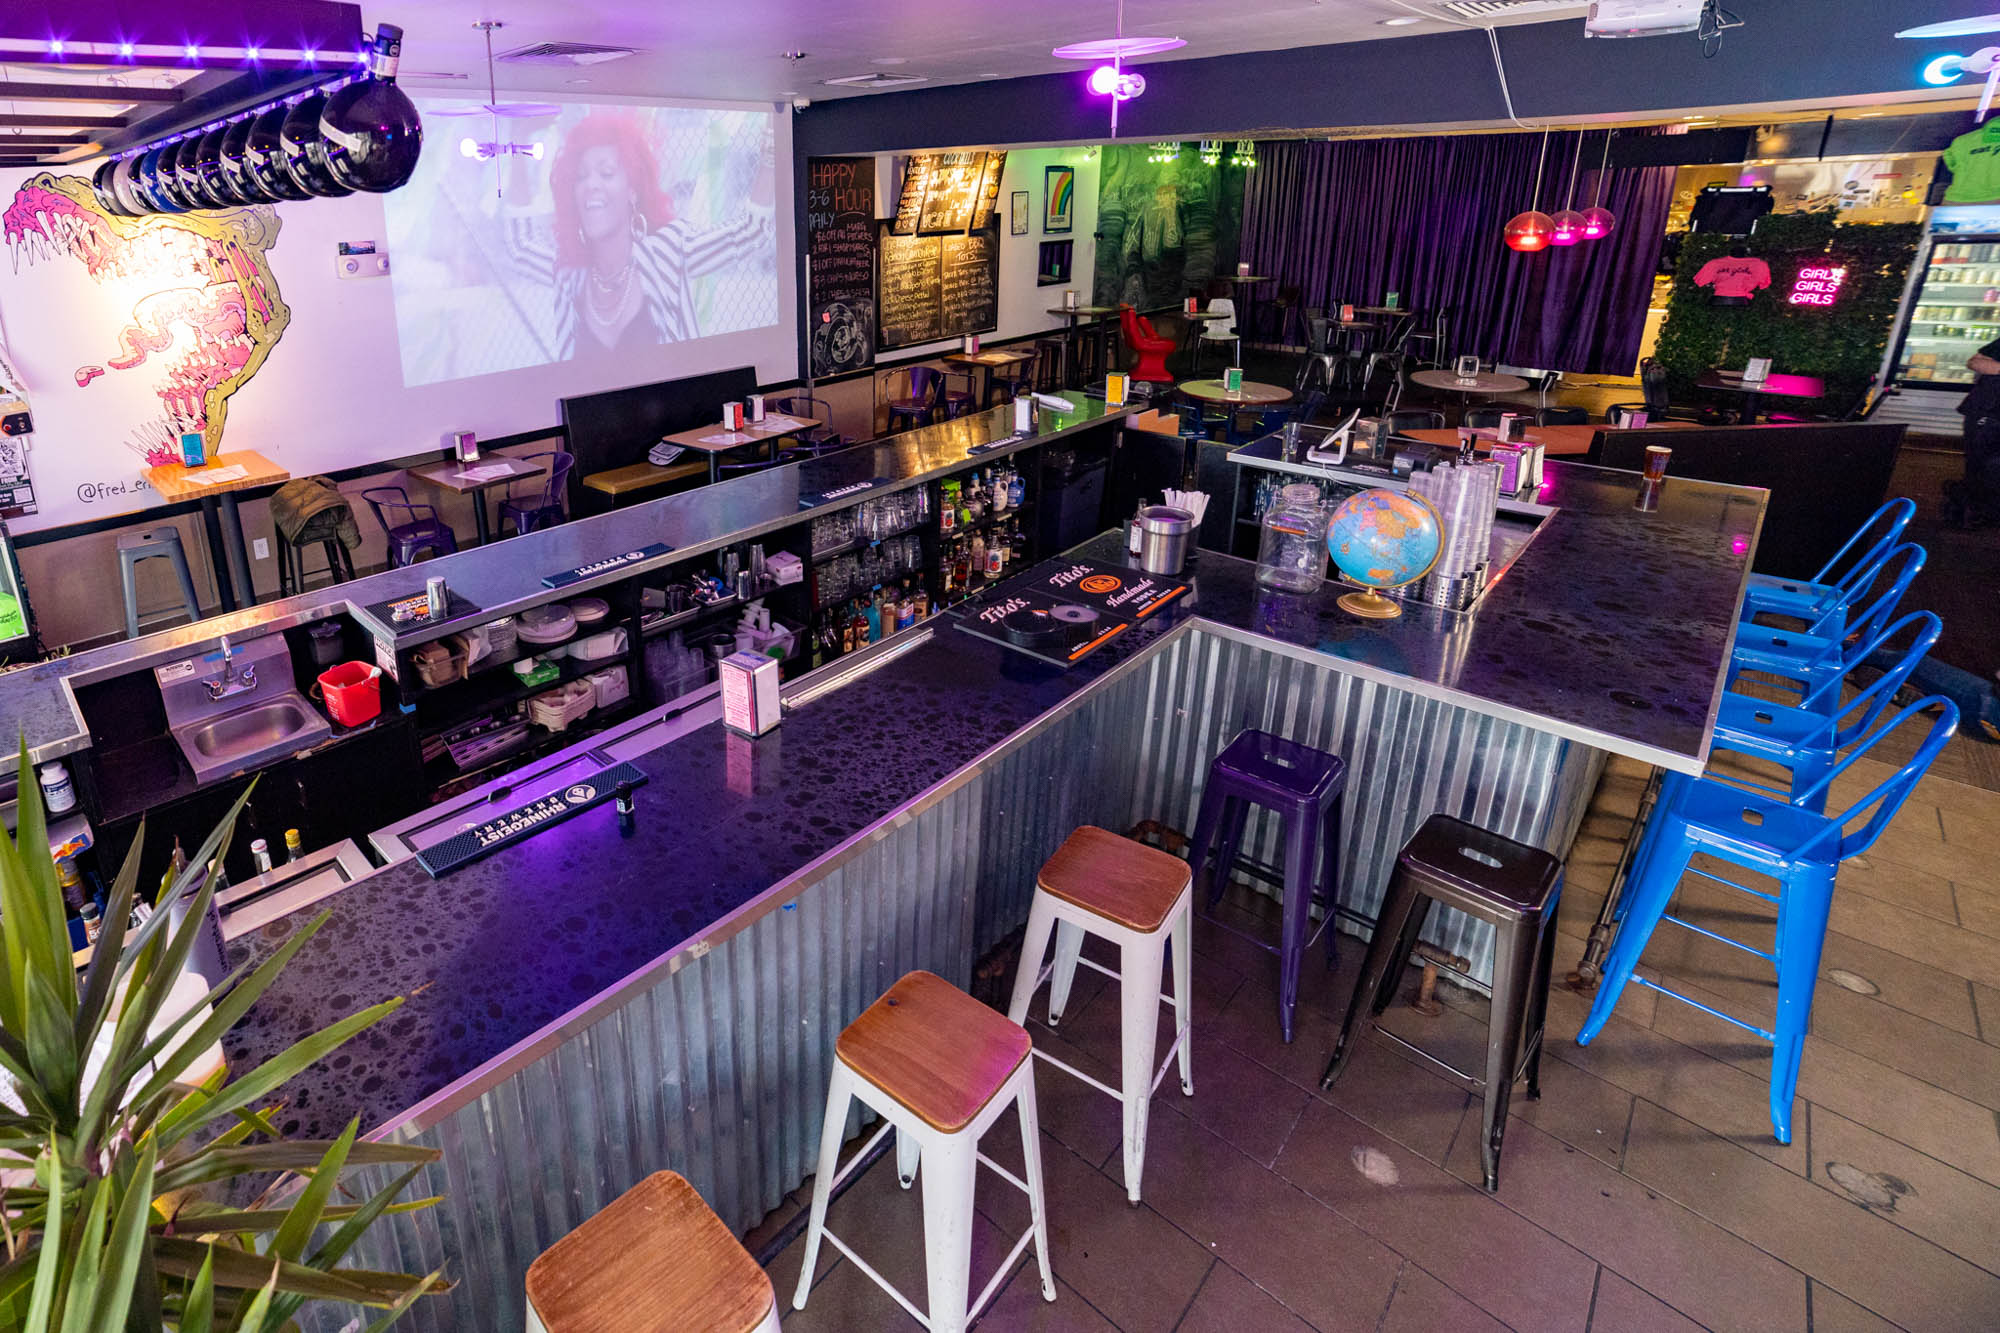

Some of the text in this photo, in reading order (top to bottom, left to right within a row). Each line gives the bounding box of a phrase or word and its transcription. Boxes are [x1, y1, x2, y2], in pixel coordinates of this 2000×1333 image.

[812, 163, 857, 188] HAPPY
[809, 190, 830, 208] 3-6
[834, 187, 872, 211] HOUR
[1791, 293, 1833, 304] GIRLS
[1795, 281, 1837, 292] GIRLS
[1105, 577, 1154, 608] Handmade
[474, 796, 558, 839] BREWERY
[480, 802, 568, 847] RHINEGEIST
